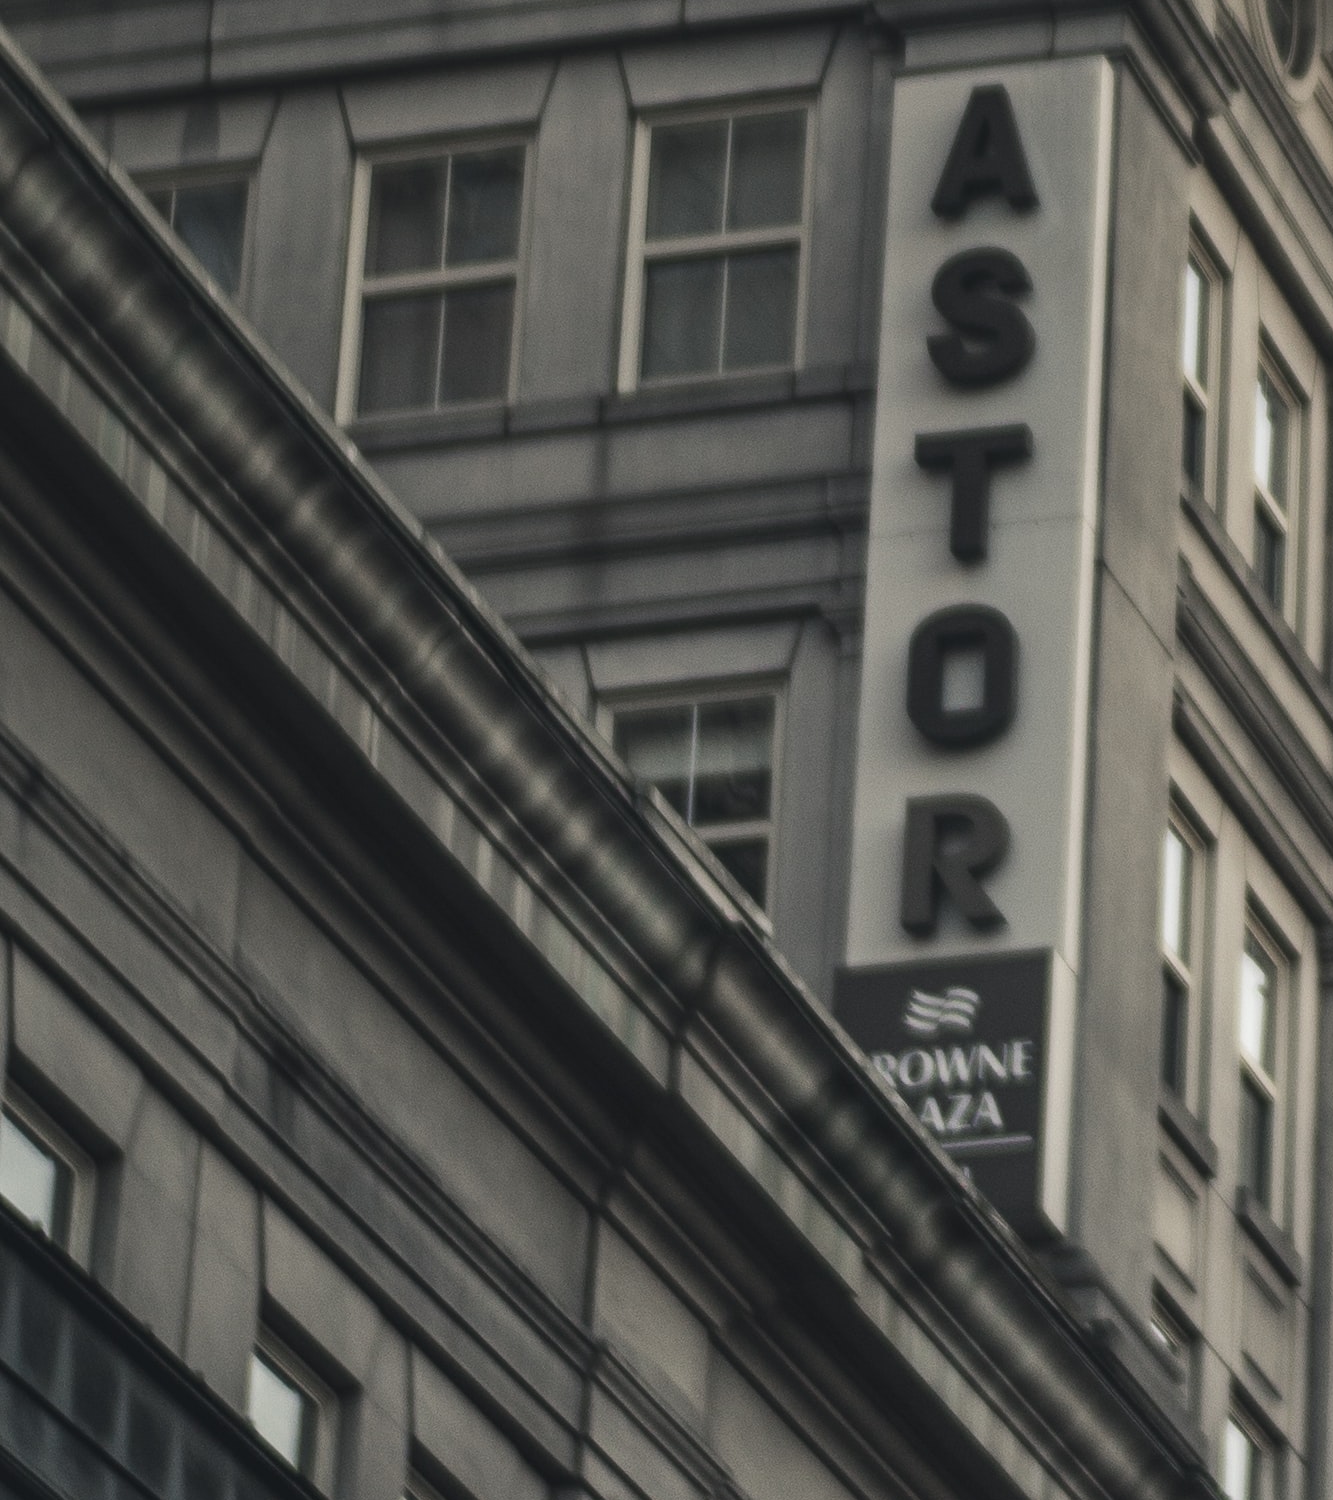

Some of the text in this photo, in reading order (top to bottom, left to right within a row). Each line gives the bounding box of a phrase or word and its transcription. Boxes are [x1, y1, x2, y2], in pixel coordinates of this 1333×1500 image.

[899, 84, 1040, 940] ASTOR
[872, 1040, 1033, 1088] ROWNE
[919, 1091, 1004, 1133] AZA
